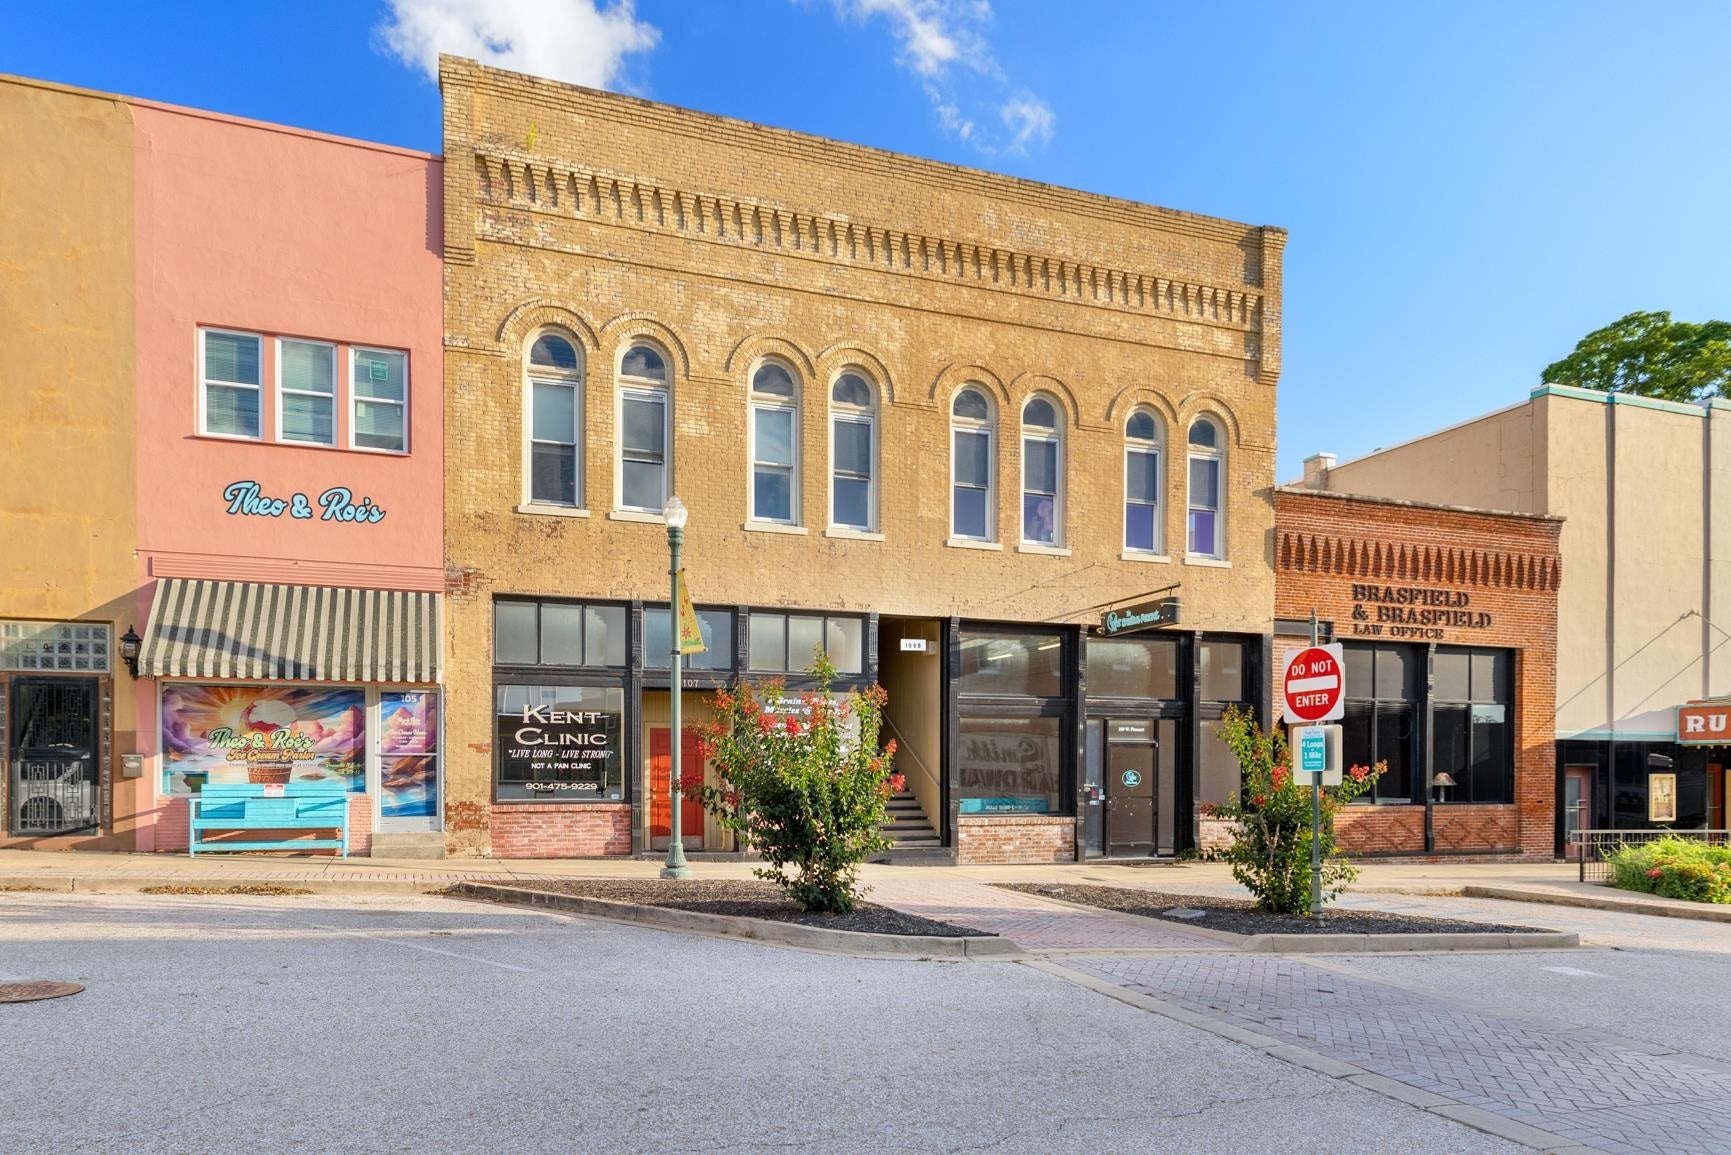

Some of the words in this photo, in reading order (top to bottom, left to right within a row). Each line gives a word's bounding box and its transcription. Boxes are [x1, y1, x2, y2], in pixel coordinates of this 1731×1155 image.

[224, 480, 288, 517] Theo
[290, 493, 313, 519] &
[319, 487, 386, 524] Roe's
[1352, 584, 1469, 607] BRASFIELD
[1352, 603, 1368, 621] &
[1377, 605, 1492, 628] BRASFIELD
[1353, 624, 1383, 635] LAW
[1390, 625, 1444, 639] OFFICE
[1291, 664, 1306, 676] DO
[1311, 660, 1332, 674] NOT
[683, 679, 699, 688] 107
[401, 694, 417, 703] 105
[1296, 693, 1329, 708] ENTER
[208, 727, 250, 749] Theo
[252, 733, 265, 749] &
[270, 727, 315, 749] Roe's
[226, 749, 247, 761] Ice
[247, 750, 280, 762] Cream
[281, 750, 315, 761] Parlor
[532, 750, 554, 758] LONG
[561, 750, 579, 759] LIVE
[525, 782, 598, 791] 901-475-9229
